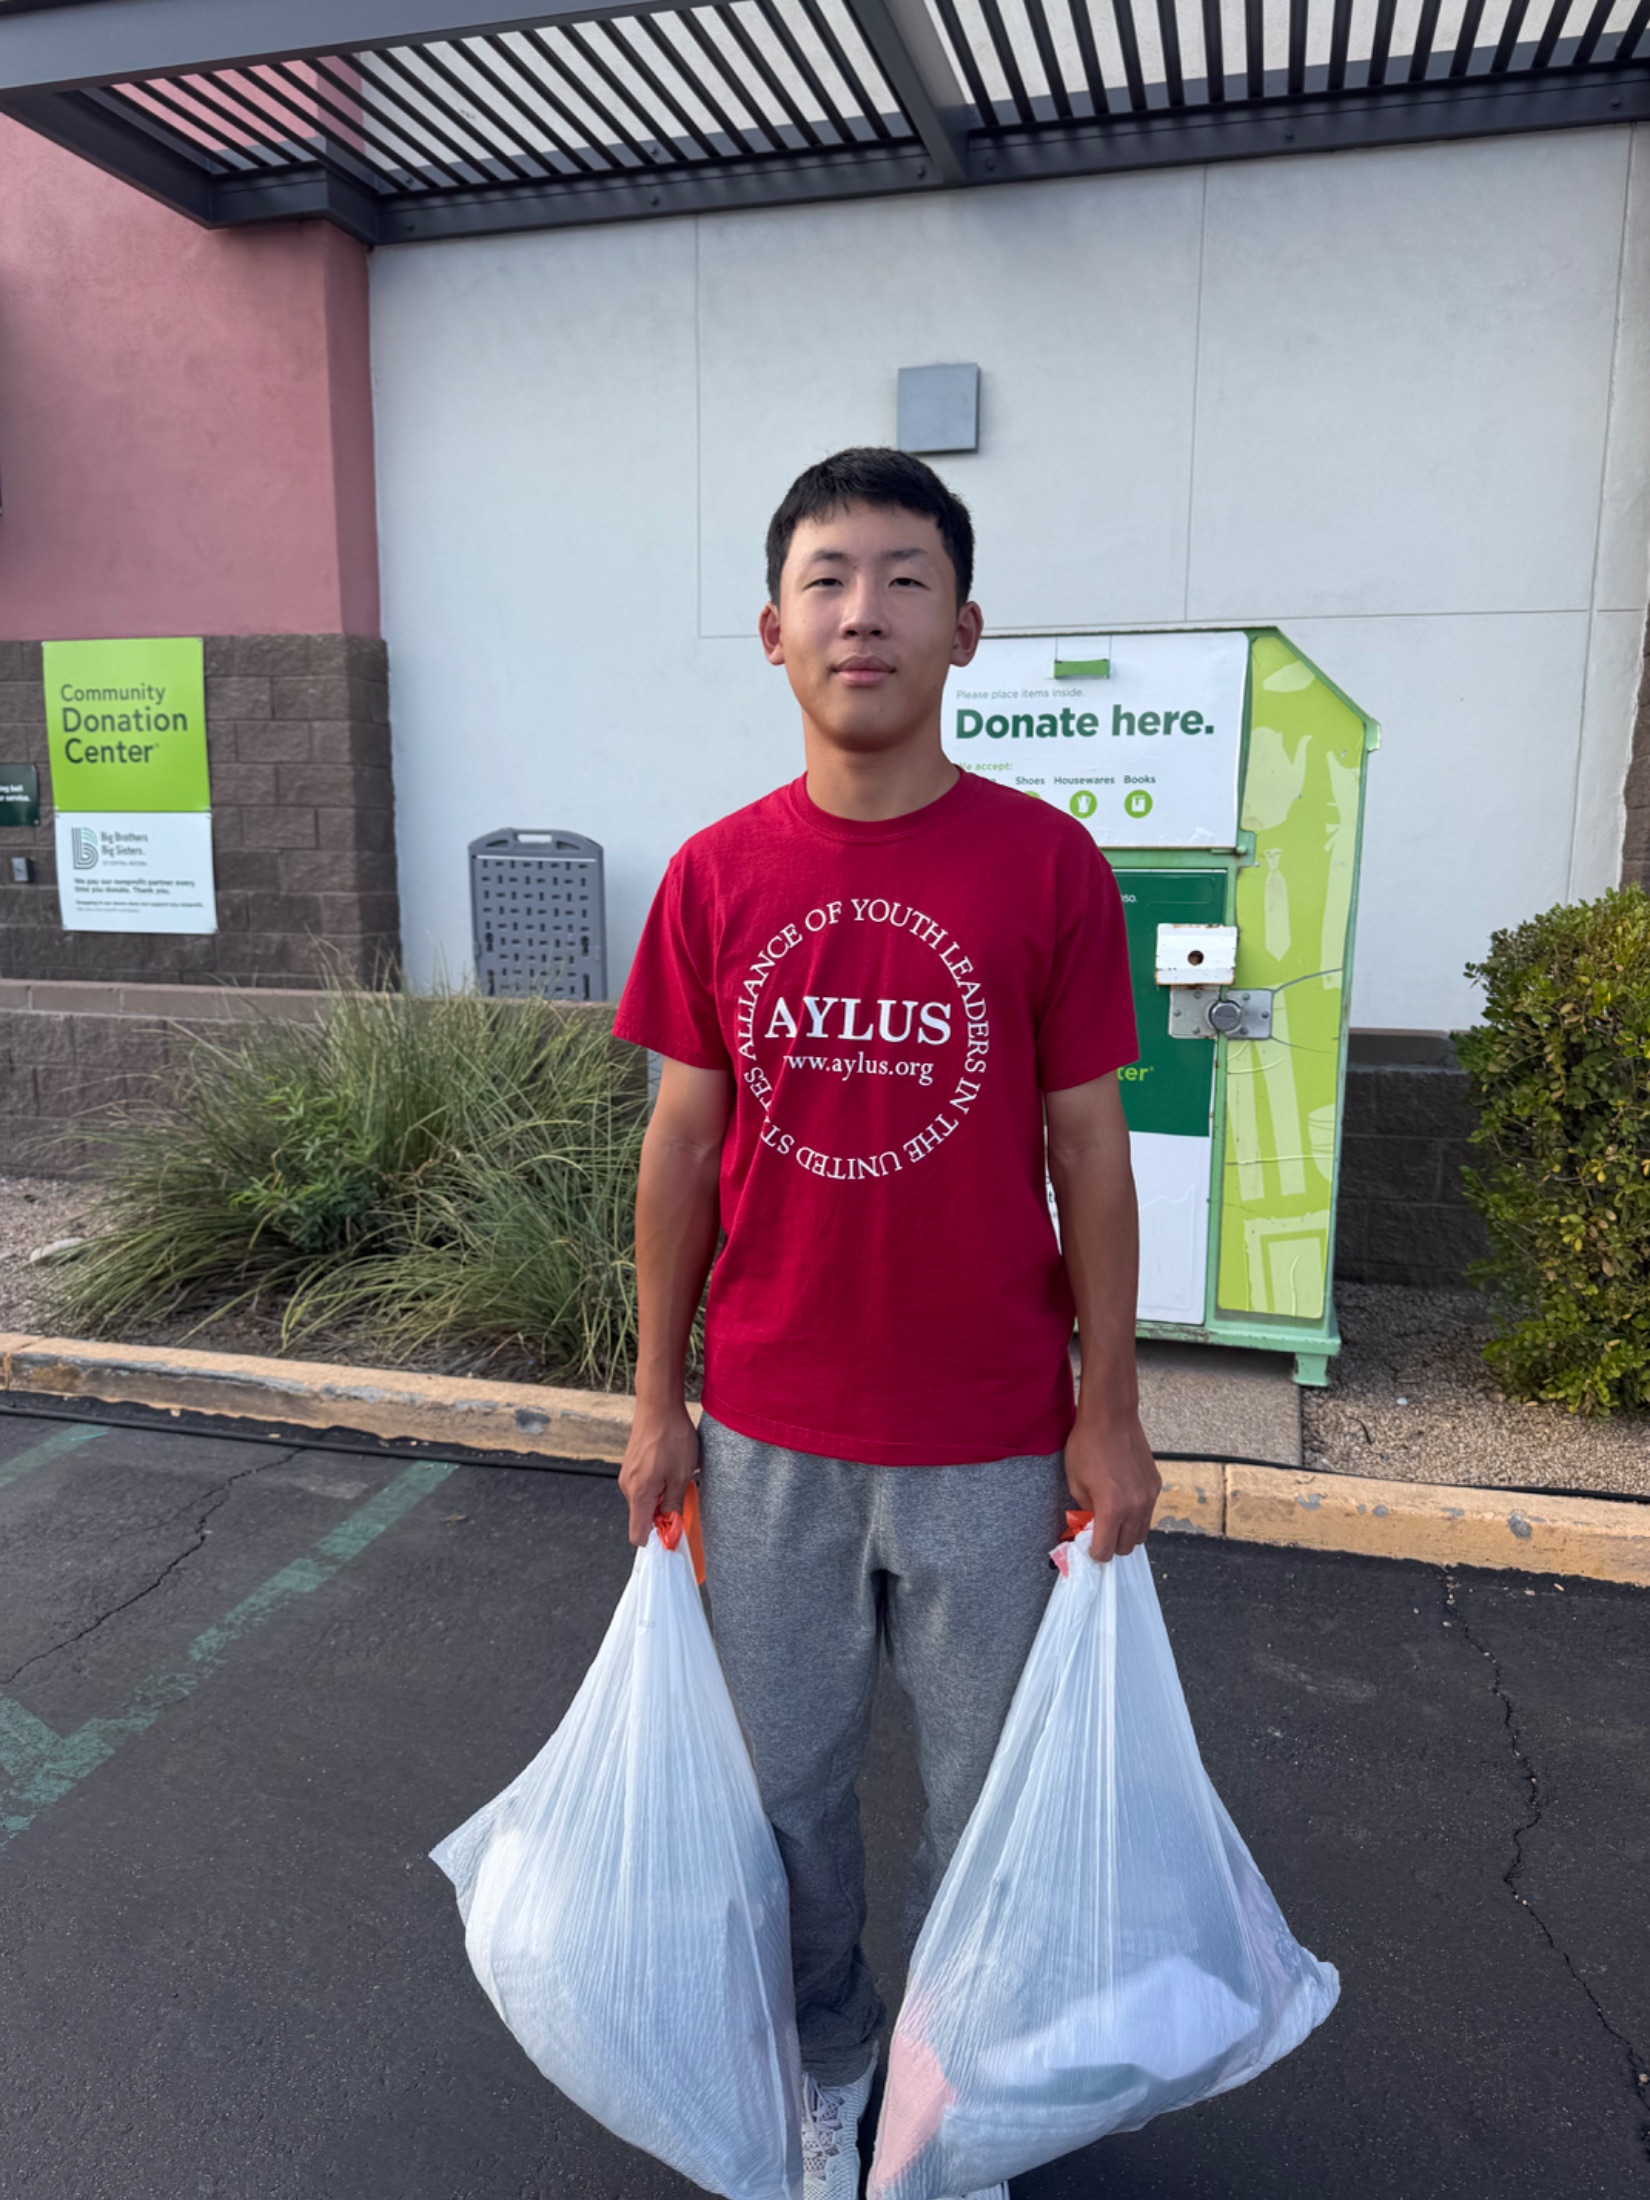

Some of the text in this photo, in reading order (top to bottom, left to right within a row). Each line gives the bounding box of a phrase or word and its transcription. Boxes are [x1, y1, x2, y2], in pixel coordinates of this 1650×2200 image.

[60, 682, 166, 705] Community
[956, 688, 1085, 700] Please place items inside.
[62, 706, 188, 732] Donation
[956, 704, 1215, 739] Donate here.
[65, 737, 155, 764] Center
[975, 762, 1013, 772] accept:
[1015, 774, 1156, 785] Shoes Housewares Books
[101, 831, 149, 844] Big Brothers
[101, 845, 115, 858] Big
[804, 901, 843, 932] OF
[851, 898, 948, 950] YOUTH
[738, 923, 803, 1060] ALLIANCE
[939, 941, 990, 1074] LEADERS
[765, 996, 951, 1045] AYLUS
[783, 1051, 934, 1086] ww.aylus.org
[949, 1076, 981, 1115] IN
[903, 1113, 959, 1163] THE
[795, 1146, 903, 1180] UNITED
